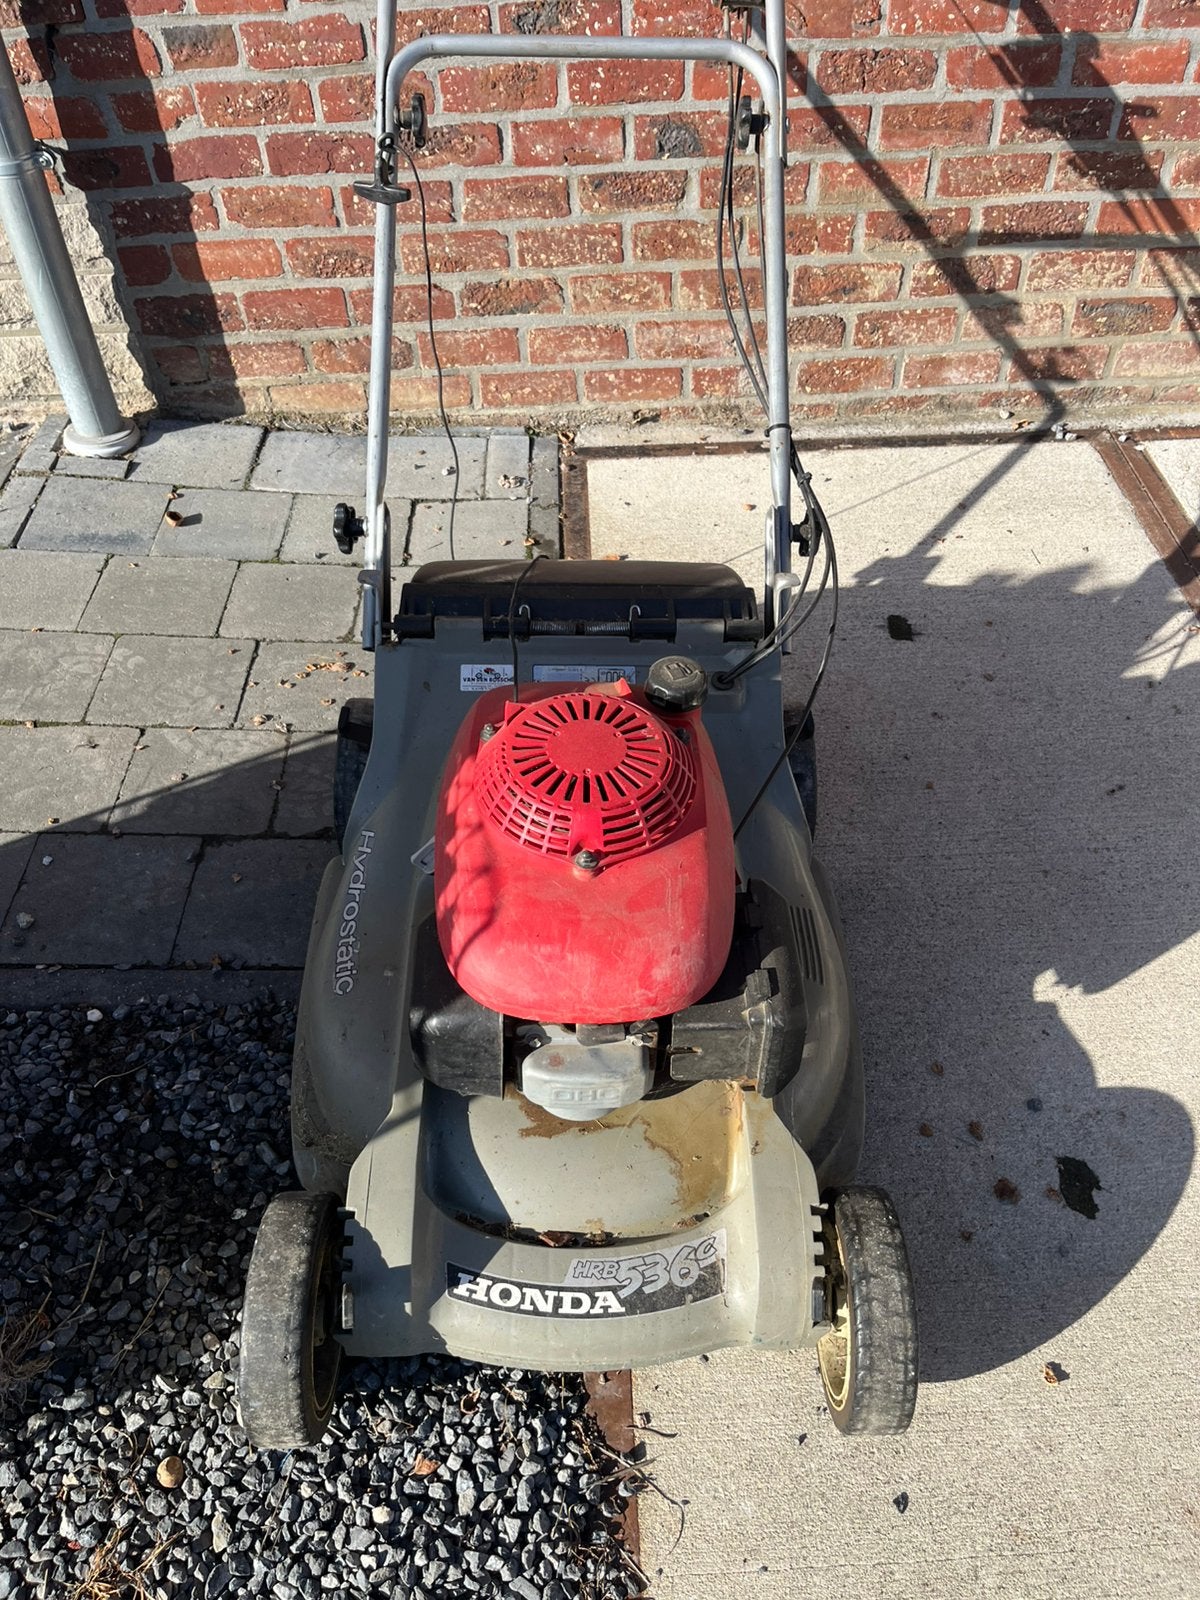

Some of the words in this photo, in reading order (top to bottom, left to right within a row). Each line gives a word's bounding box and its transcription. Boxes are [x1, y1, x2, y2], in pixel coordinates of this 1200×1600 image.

[335, 830, 375, 996] Hydrostatic
[551, 1087, 622, 1102] OHC
[452, 1272, 625, 1314] HONDA
